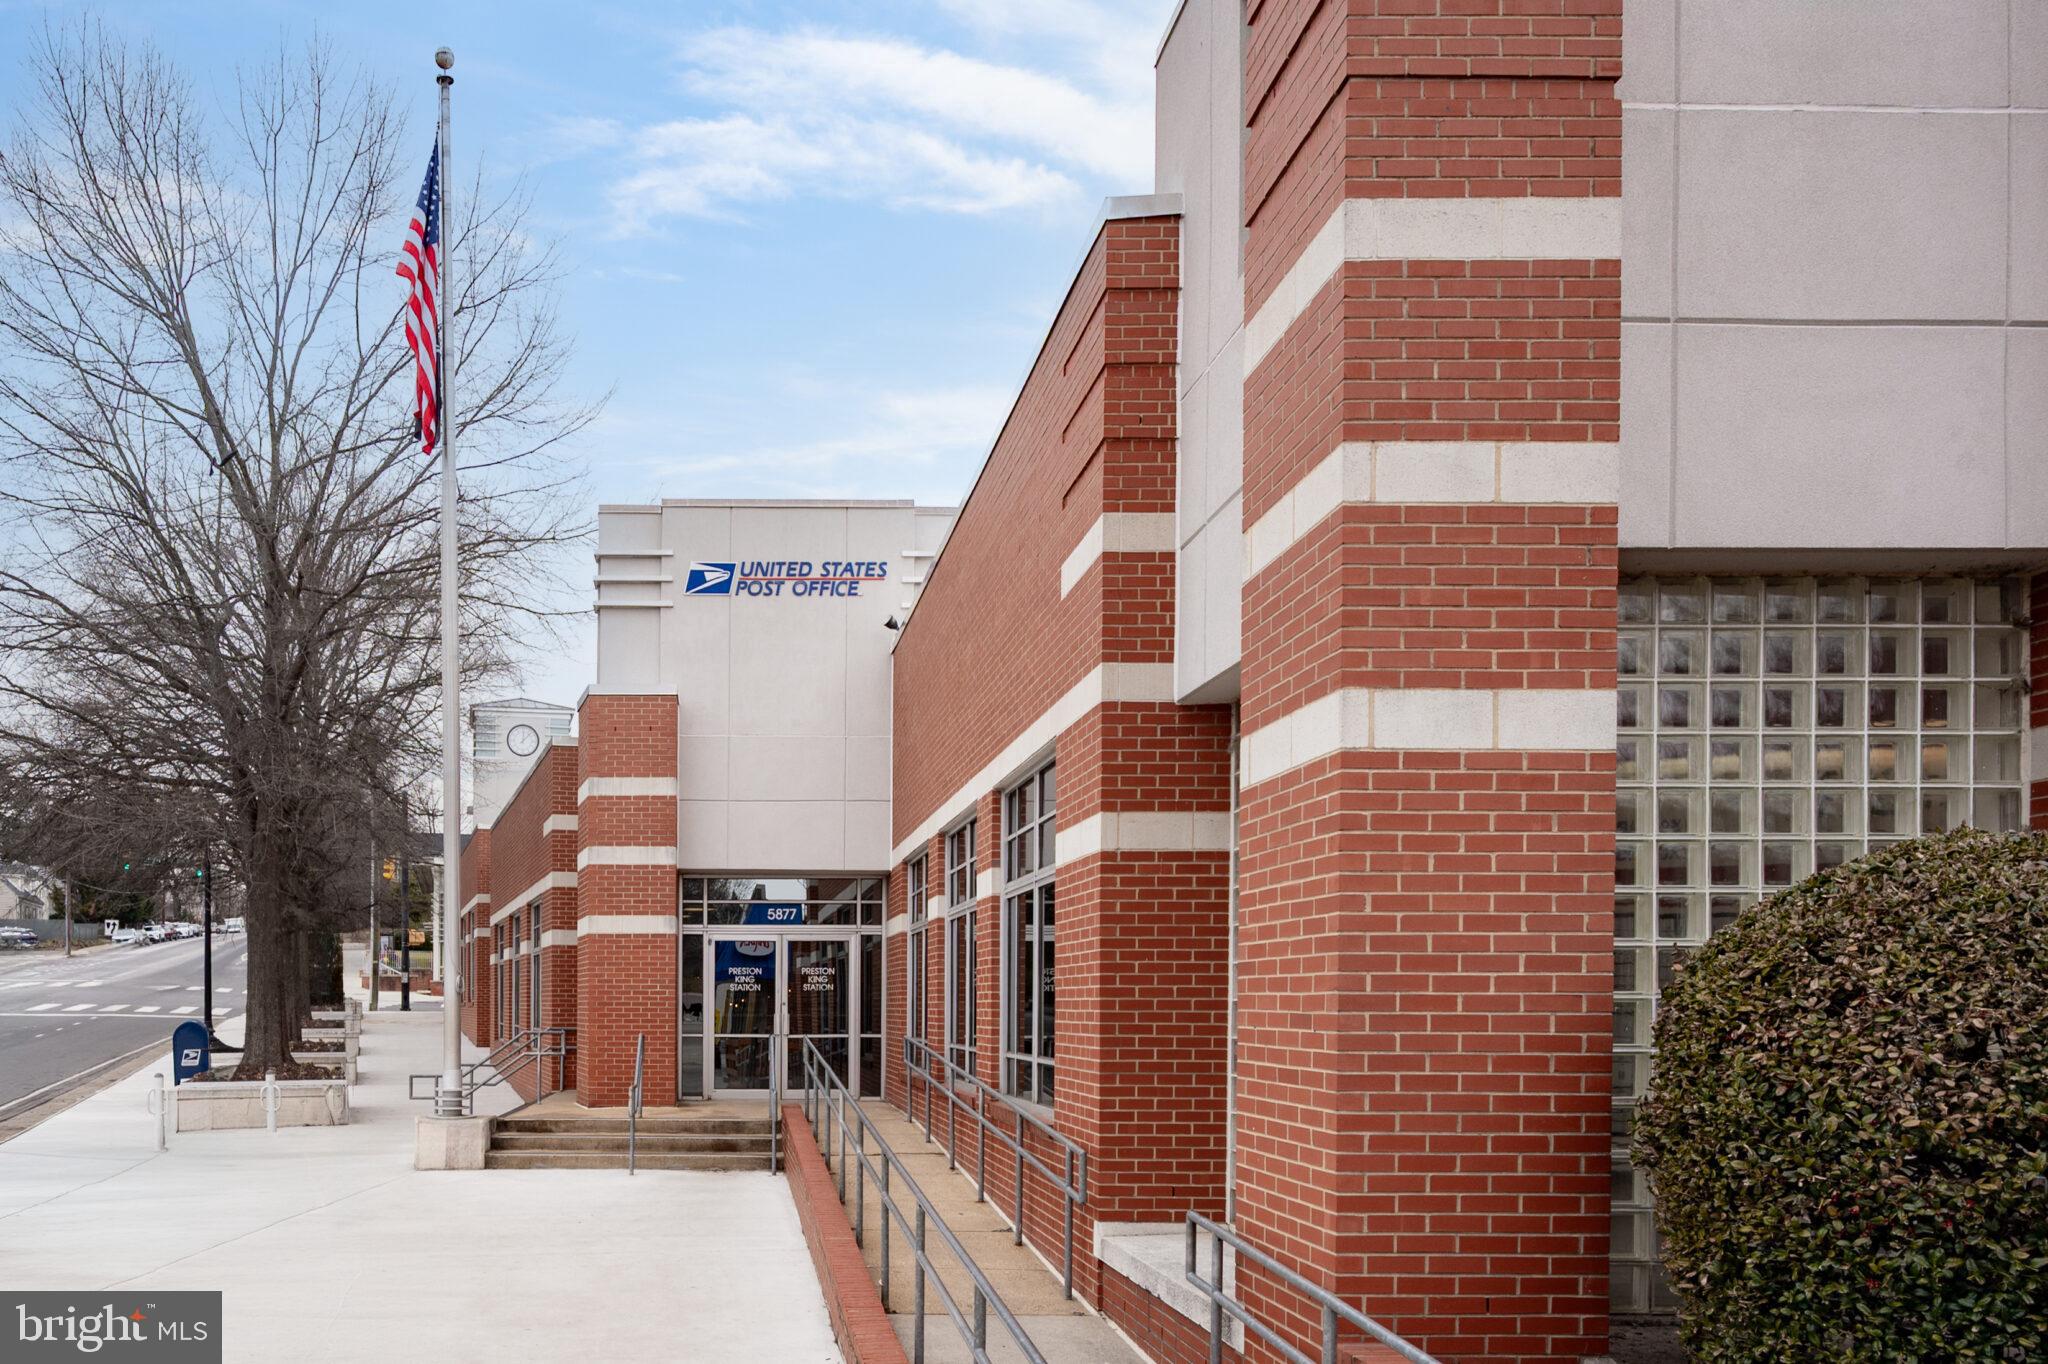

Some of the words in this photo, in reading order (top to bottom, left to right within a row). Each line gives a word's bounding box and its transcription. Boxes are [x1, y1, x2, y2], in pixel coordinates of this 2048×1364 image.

[739, 561, 812, 578] UNITED
[820, 561, 887, 578] STATES
[735, 581, 785, 597] POST
[792, 581, 860, 597] OFFICE
[767, 908, 797, 920] 5877
[728, 967, 762, 975] PRESTON
[801, 967, 835, 975] PRESTON
[735, 975, 755, 983] KING
[807, 975, 828, 983] KING
[730, 983, 761, 991] STATION
[803, 983, 834, 991] STATION
